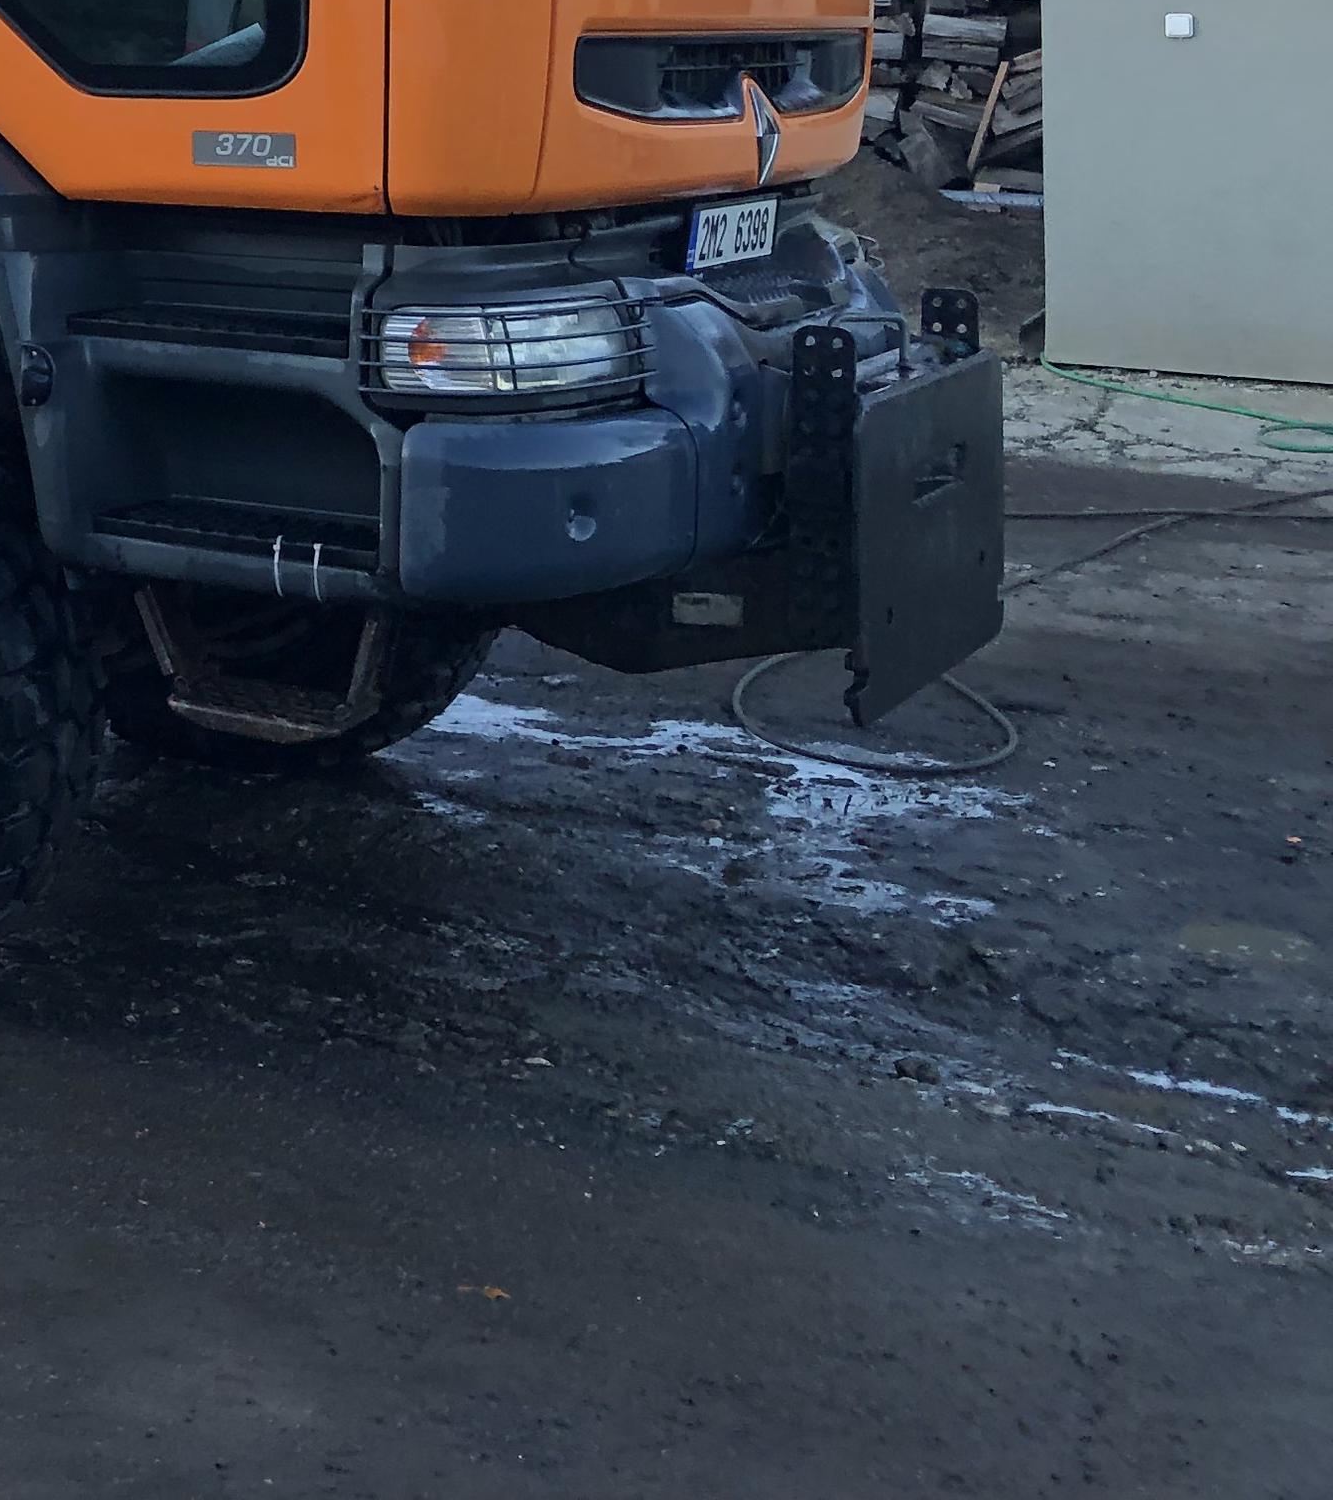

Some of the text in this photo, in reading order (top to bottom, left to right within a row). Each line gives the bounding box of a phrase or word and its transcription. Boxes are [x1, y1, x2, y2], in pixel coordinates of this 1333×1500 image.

[215, 133, 272, 157] 370
[699, 206, 769, 261] 2M2 6398
